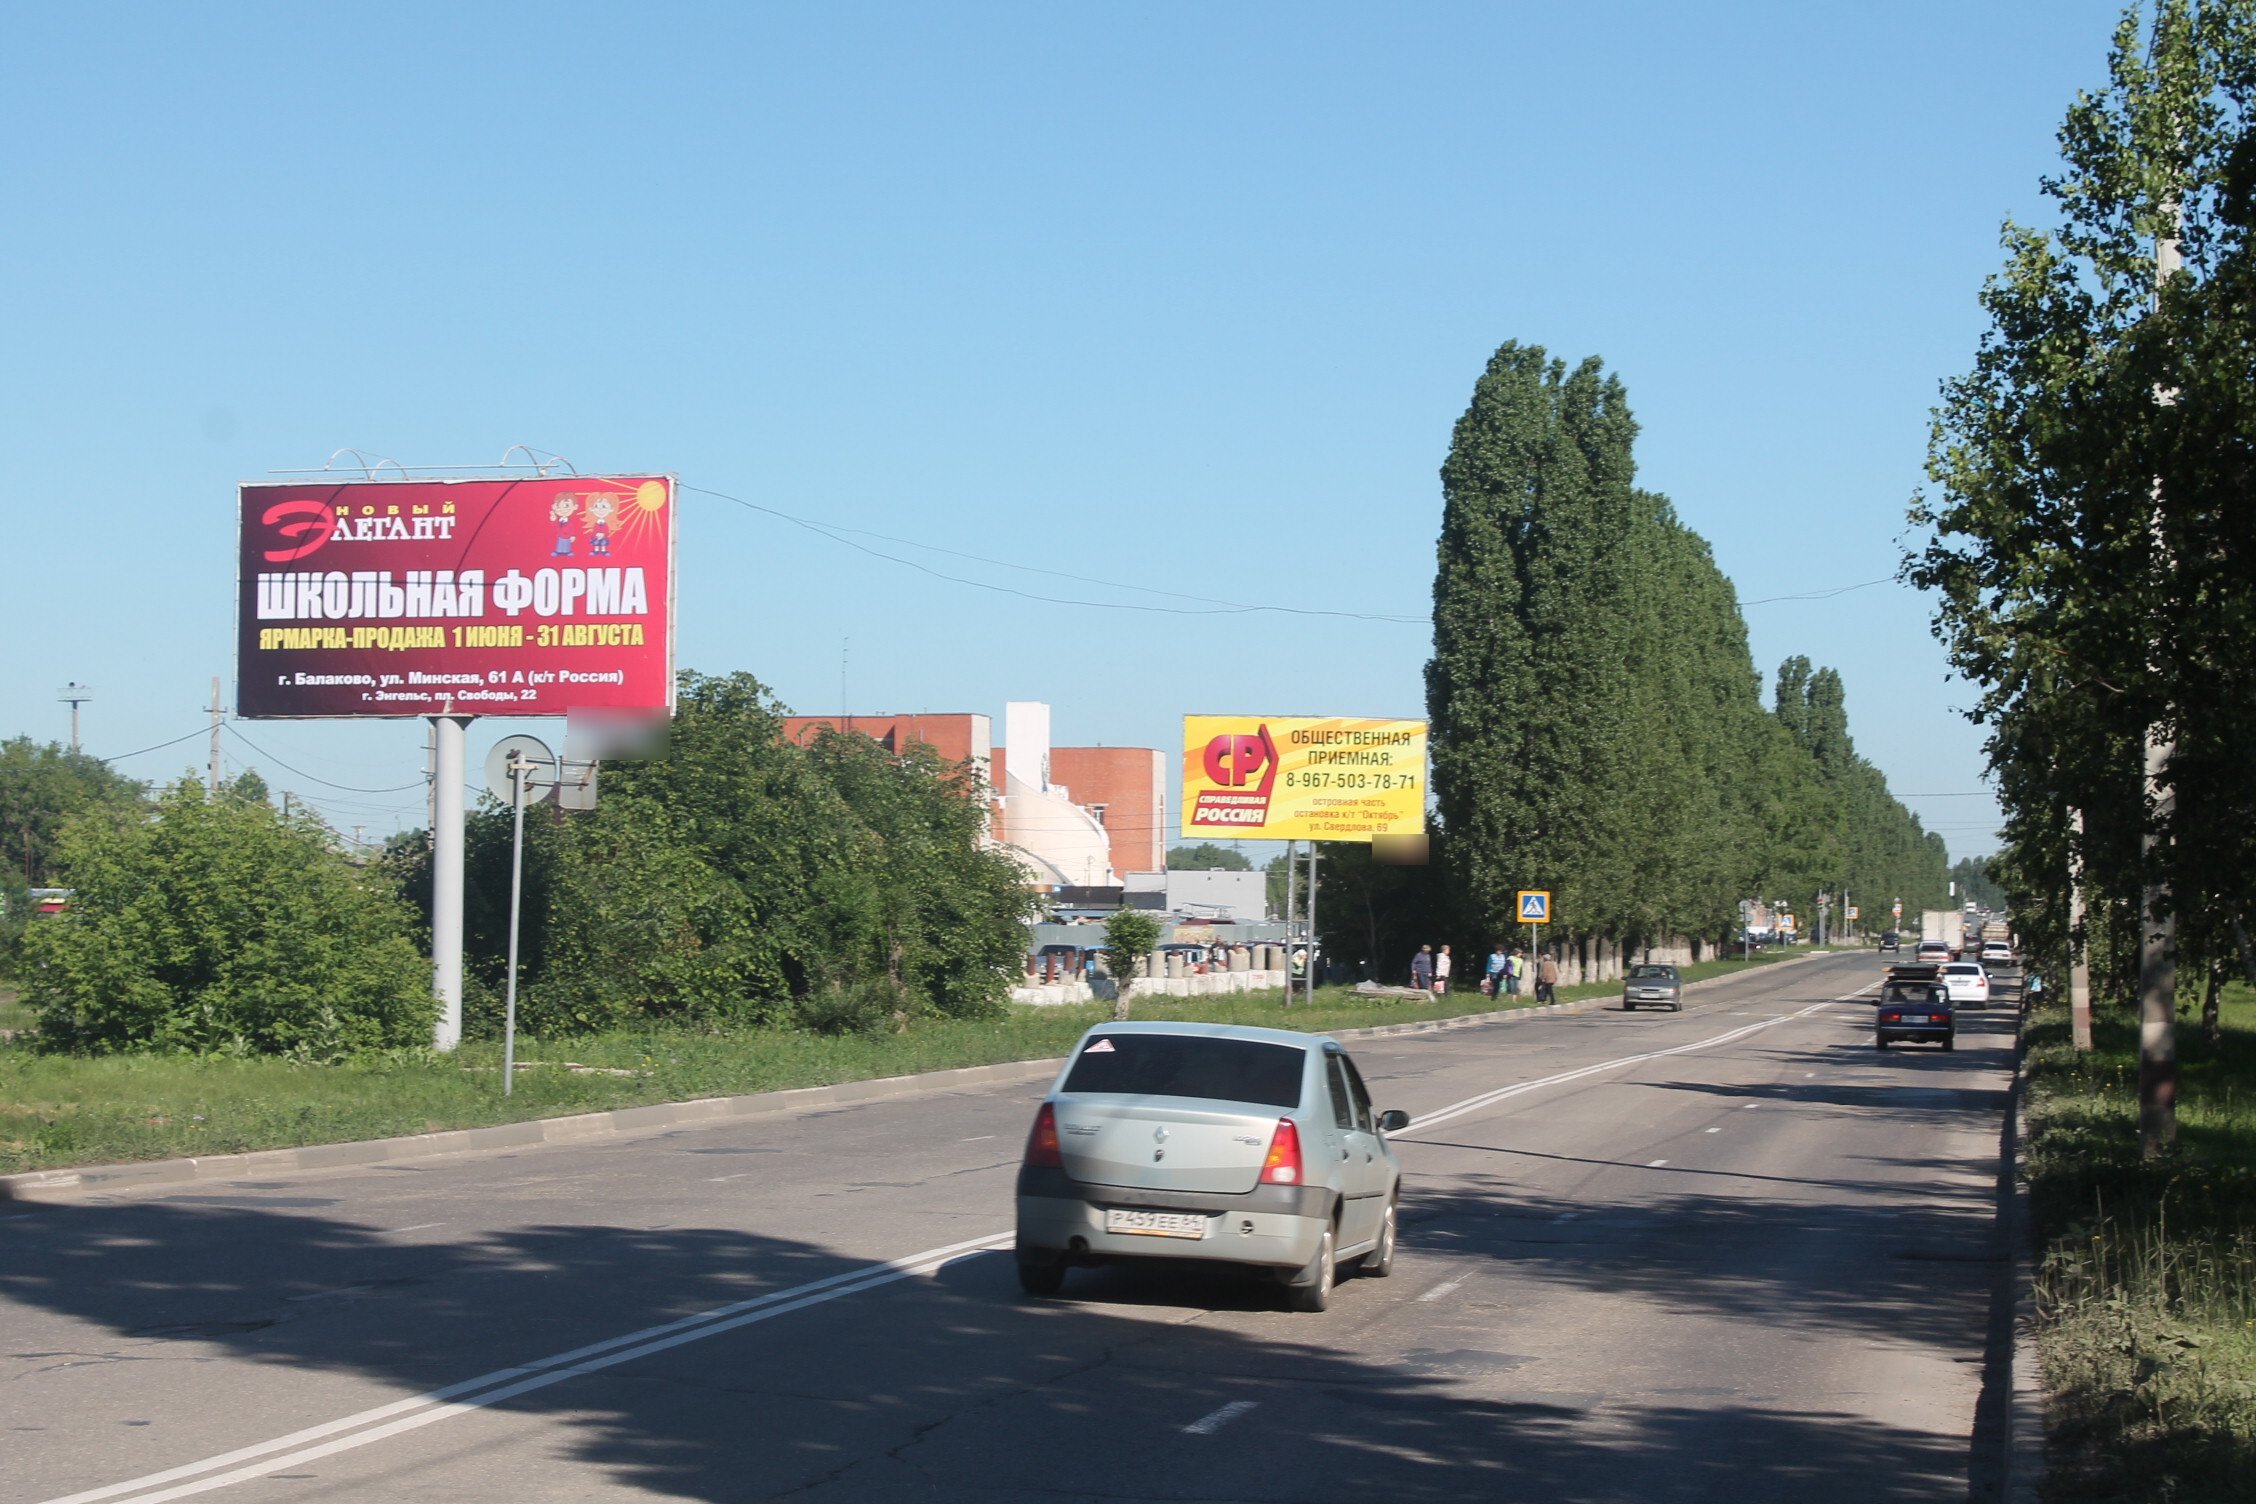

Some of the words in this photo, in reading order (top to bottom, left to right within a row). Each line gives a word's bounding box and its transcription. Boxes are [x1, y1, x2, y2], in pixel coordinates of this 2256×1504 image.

[336, 501, 455, 515] НОВЫЙ
[257, 570, 484, 620] ШКОЛЬНАЯ
[493, 567, 648, 617] ФОРМА
[259, 626, 446, 651] ЯРМАРКА-ПРОДАЖА
[452, 626, 462, 647] 1
[465, 625, 523, 647] ИЮНЯ
[537, 624, 559, 647] 31
[561, 623, 645, 646] АВГУСТА
[278, 675, 291, 686] г.
[295, 672, 376, 687] Балаково,
[380, 674, 404, 687] ул.
[408, 671, 484, 687] Минская,
[488, 671, 507, 684] 61
[528, 670, 555, 686] (к/т
[559, 669, 624, 686] Россия)
[362, 691, 372, 701] г.
[375, 690, 432, 702] Энгельс,
[435, 691, 455, 701] пл.
[457, 689, 518, 702] Свободы,
[520, 689, 537, 700] 22
[1291, 729, 1411, 747] ОБЩЕСТВЕННАЯ
[1308, 750, 1394, 766] ПРИЕМНАЯ:
[1286, 772, 1415, 789] 8-967-503-78-71
[1198, 795, 1267, 805] СПРАВЕДЛИВАЯ
[1312, 798, 1358, 809] островная
[1361, 799, 1386, 807] часть
[1194, 807, 1265, 823] РОССИЯ
[1294, 809, 1340, 818] остановка
